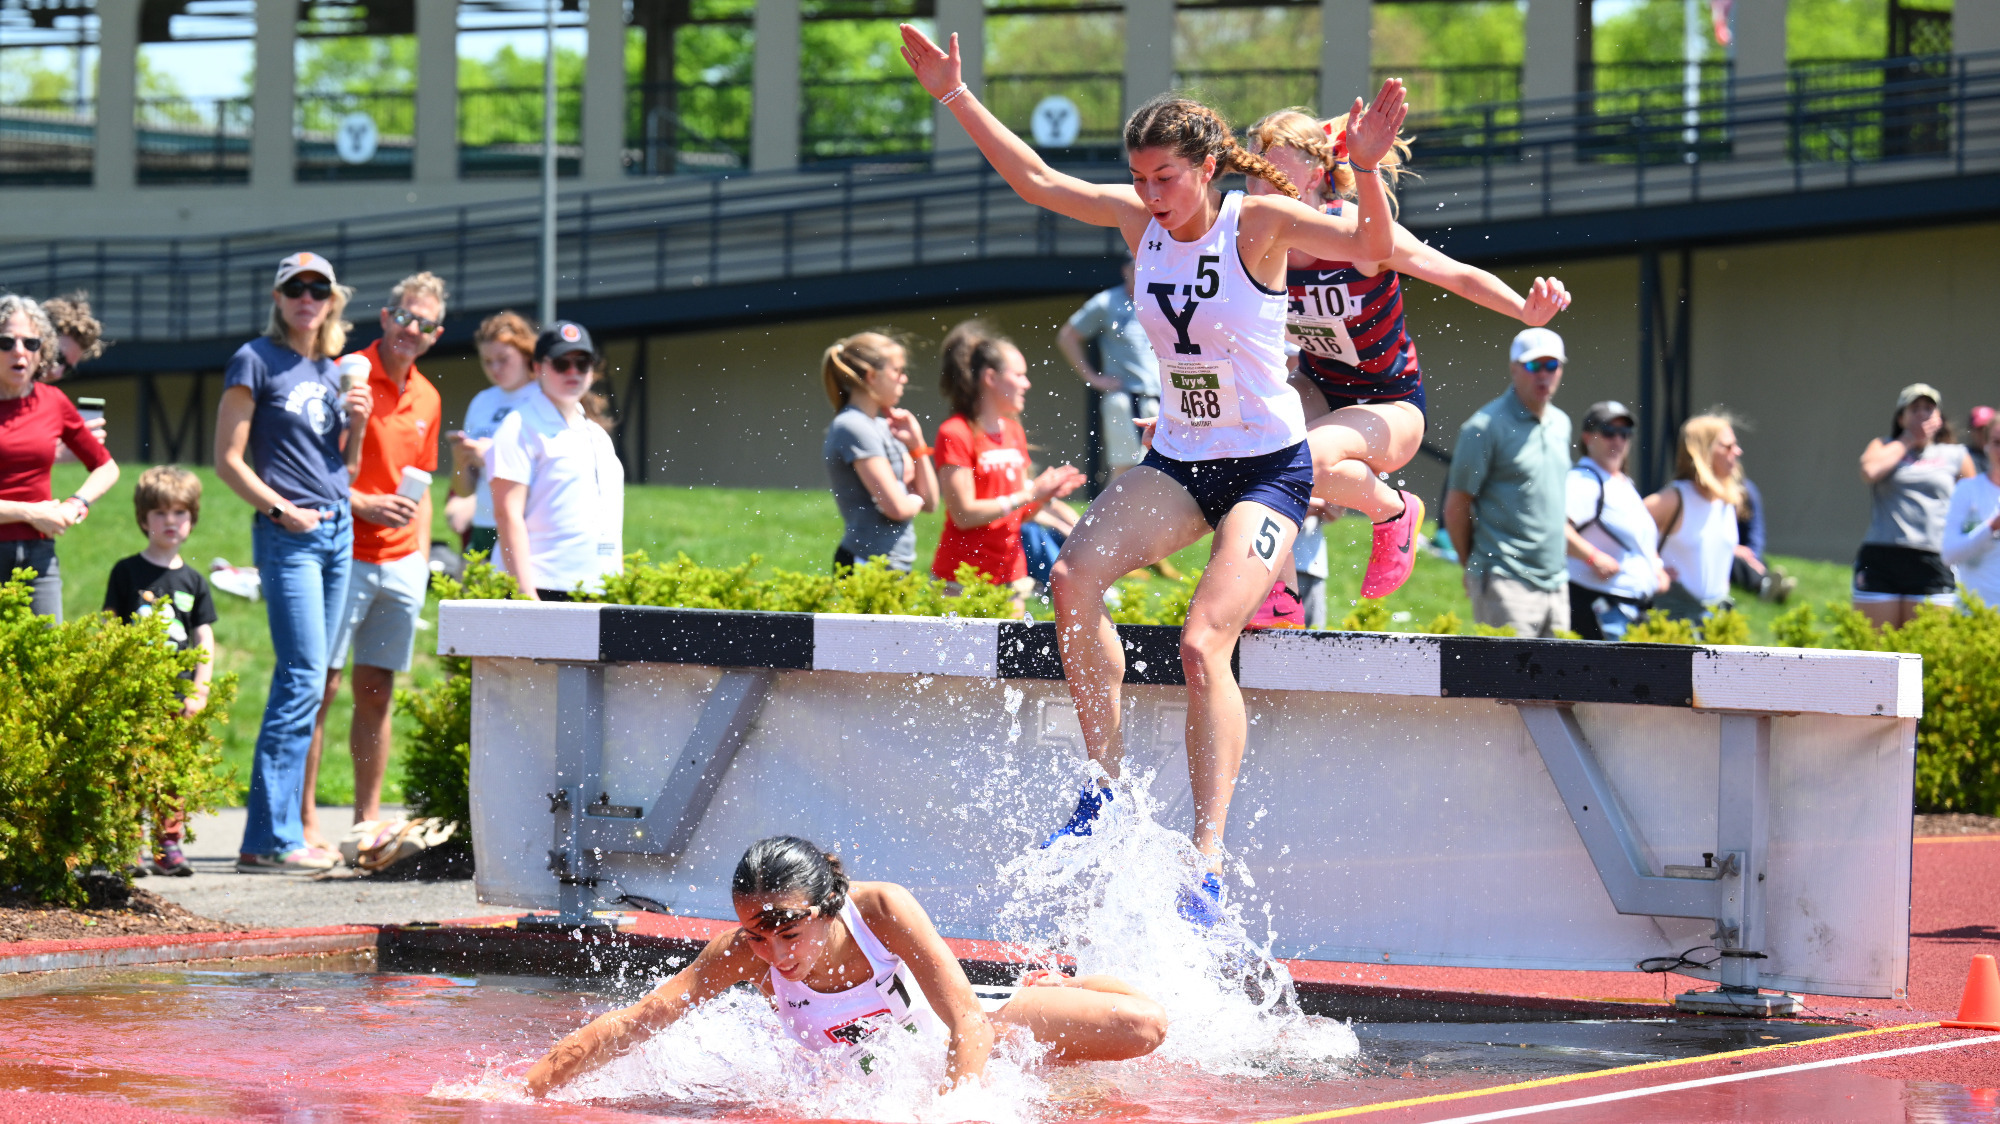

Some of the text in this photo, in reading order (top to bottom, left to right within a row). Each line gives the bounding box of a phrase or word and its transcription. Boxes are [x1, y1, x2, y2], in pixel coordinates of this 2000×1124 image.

[346, 124, 368, 153] Y
[1044, 110, 1068, 138] Y
[1194, 255, 1220, 299] 5
[1308, 286, 1345, 317] 10
[1147, 282, 1202, 355] Y
[1297, 335, 1343, 355] 316
[1180, 375, 1196, 388] Ivy
[1181, 390, 1221, 419] 468
[1256, 516, 1281, 560] 5
[887, 973, 911, 1008] 1
